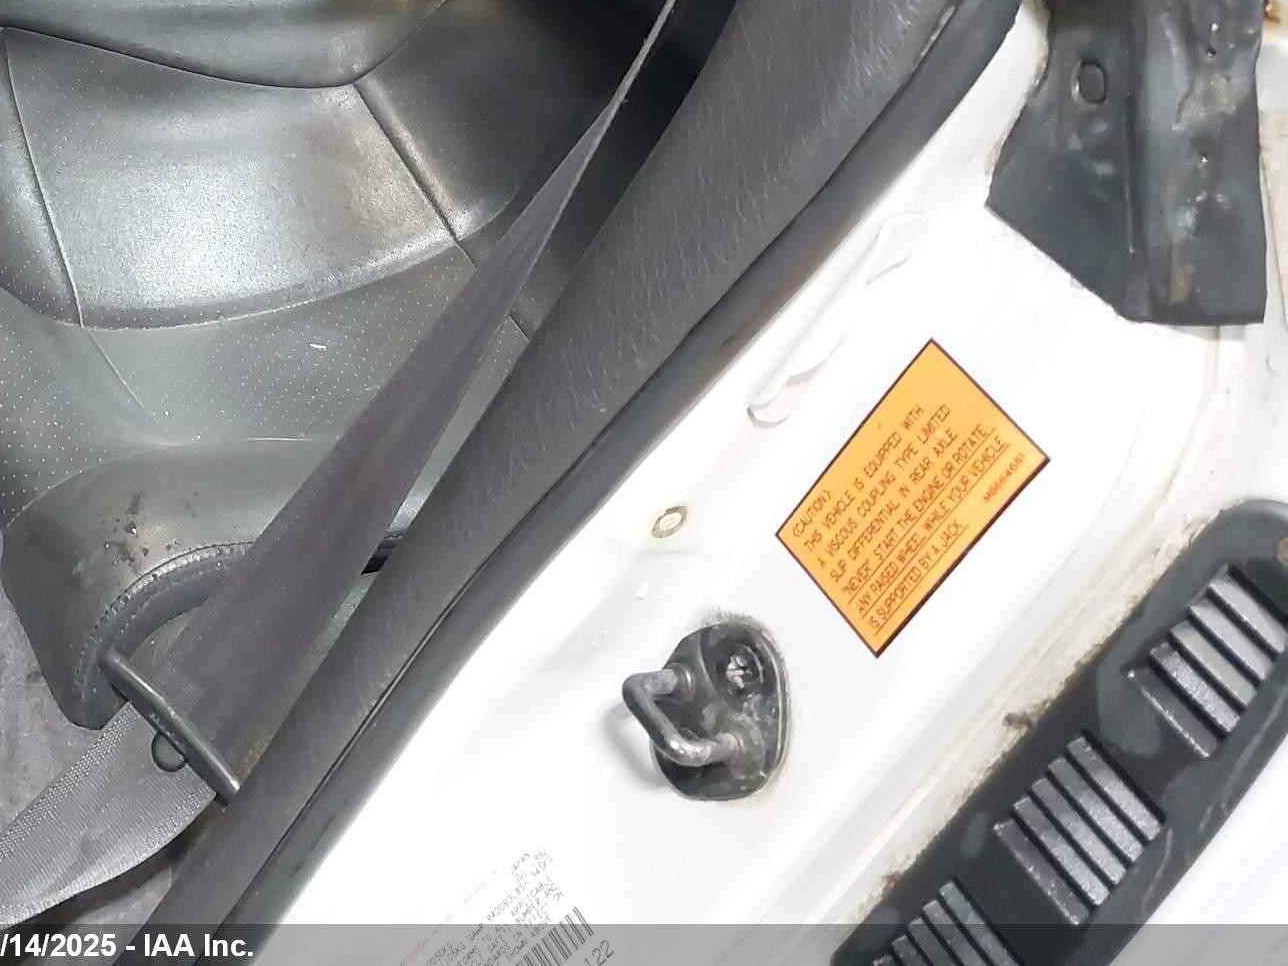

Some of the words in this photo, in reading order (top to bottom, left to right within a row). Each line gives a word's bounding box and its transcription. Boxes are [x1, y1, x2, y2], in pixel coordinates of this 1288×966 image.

[803, 528, 823, 552] THIS
[822, 488, 855, 529] VEHICLE
[852, 476, 865, 491] IS
[862, 430, 902, 478] EQUIPPED
[900, 403, 923, 431] WITH
[815, 555, 826, 568] A
[823, 516, 858, 558] VISCOUS
[855, 469, 896, 518] COUPLING
[893, 441, 919, 472] TYPE
[916, 403, 950, 444] LIMITED
[828, 557, 848, 583] SLIP
[845, 495, 899, 562] DIFFERENTIAL
[896, 483, 910, 498] IN
[908, 455, 932, 484] REAR
[930, 426, 957, 458] AXLE
[853, 589, 874, 614] ANY
[869, 559, 898, 595] RAISED
[895, 529, 925, 564] WHEEL
[922, 499, 950, 533] WHILE
[945, 473, 971, 504] YOUR
[967, 434, 1005, 478] VEHICLE
[872, 527, 900, 560] START
[896, 507, 916, 531] THE
[911, 474, 944, 513] ENGINE
[939, 460, 955, 480] OR
[951, 424, 987, 465] ROTATE
[866, 614, 880, 630] IS
[875, 564, 922, 620] SUPPORTED
[917, 550, 934, 571] BY
[930, 543, 940, 555] A
